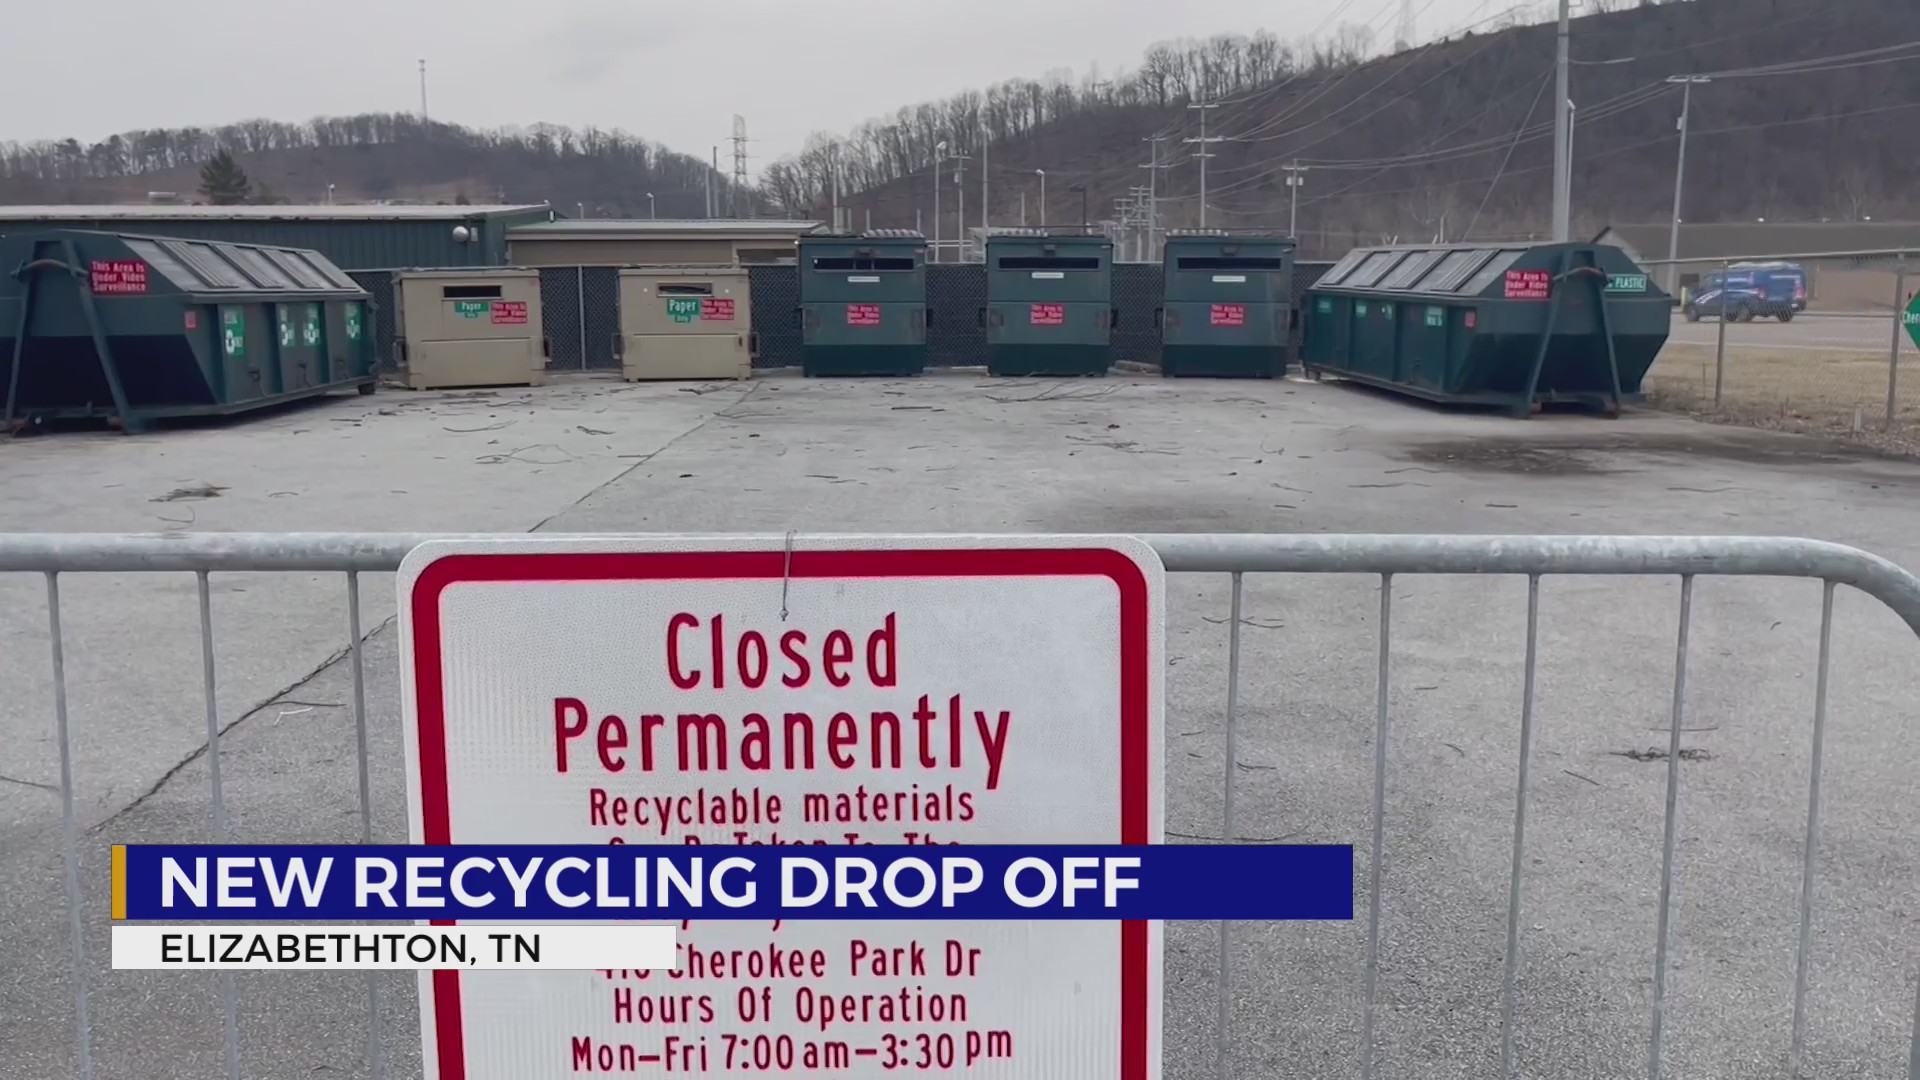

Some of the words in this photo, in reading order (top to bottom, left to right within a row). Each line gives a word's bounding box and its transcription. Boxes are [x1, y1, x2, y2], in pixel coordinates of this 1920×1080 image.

[92, 261, 110, 271] This
[112, 263, 134, 272] Area
[92, 272, 117, 281] Under
[121, 272, 145, 281] Video
[1506, 271, 1521, 279] This
[1523, 272, 1539, 280] Area
[93, 282, 146, 291] Surveillance
[1505, 281, 1525, 289] Under
[1528, 281, 1547, 289] Video
[1616, 277, 1644, 288] PLASTIC
[1504, 289, 1547, 297] Surveillance
[462, 302, 481, 312] Paper
[669, 299, 696, 314] Paper
[667, 611, 898, 690] Closed
[554, 694, 1011, 790] Permanently
[590, 788, 782, 835] Recyclable
[804, 784, 974, 822] materials
[850, 940, 926, 977] Park
[946, 940, 981, 977] Dr
[614, 988, 714, 1023] Hours
[738, 987, 772, 1023] Of
[797, 987, 968, 1031] Operation
[572, 1036, 708, 1072] Mon-Fri
[722, 1034, 794, 1070] 7:00
[966, 1030, 1013, 1066] pm
